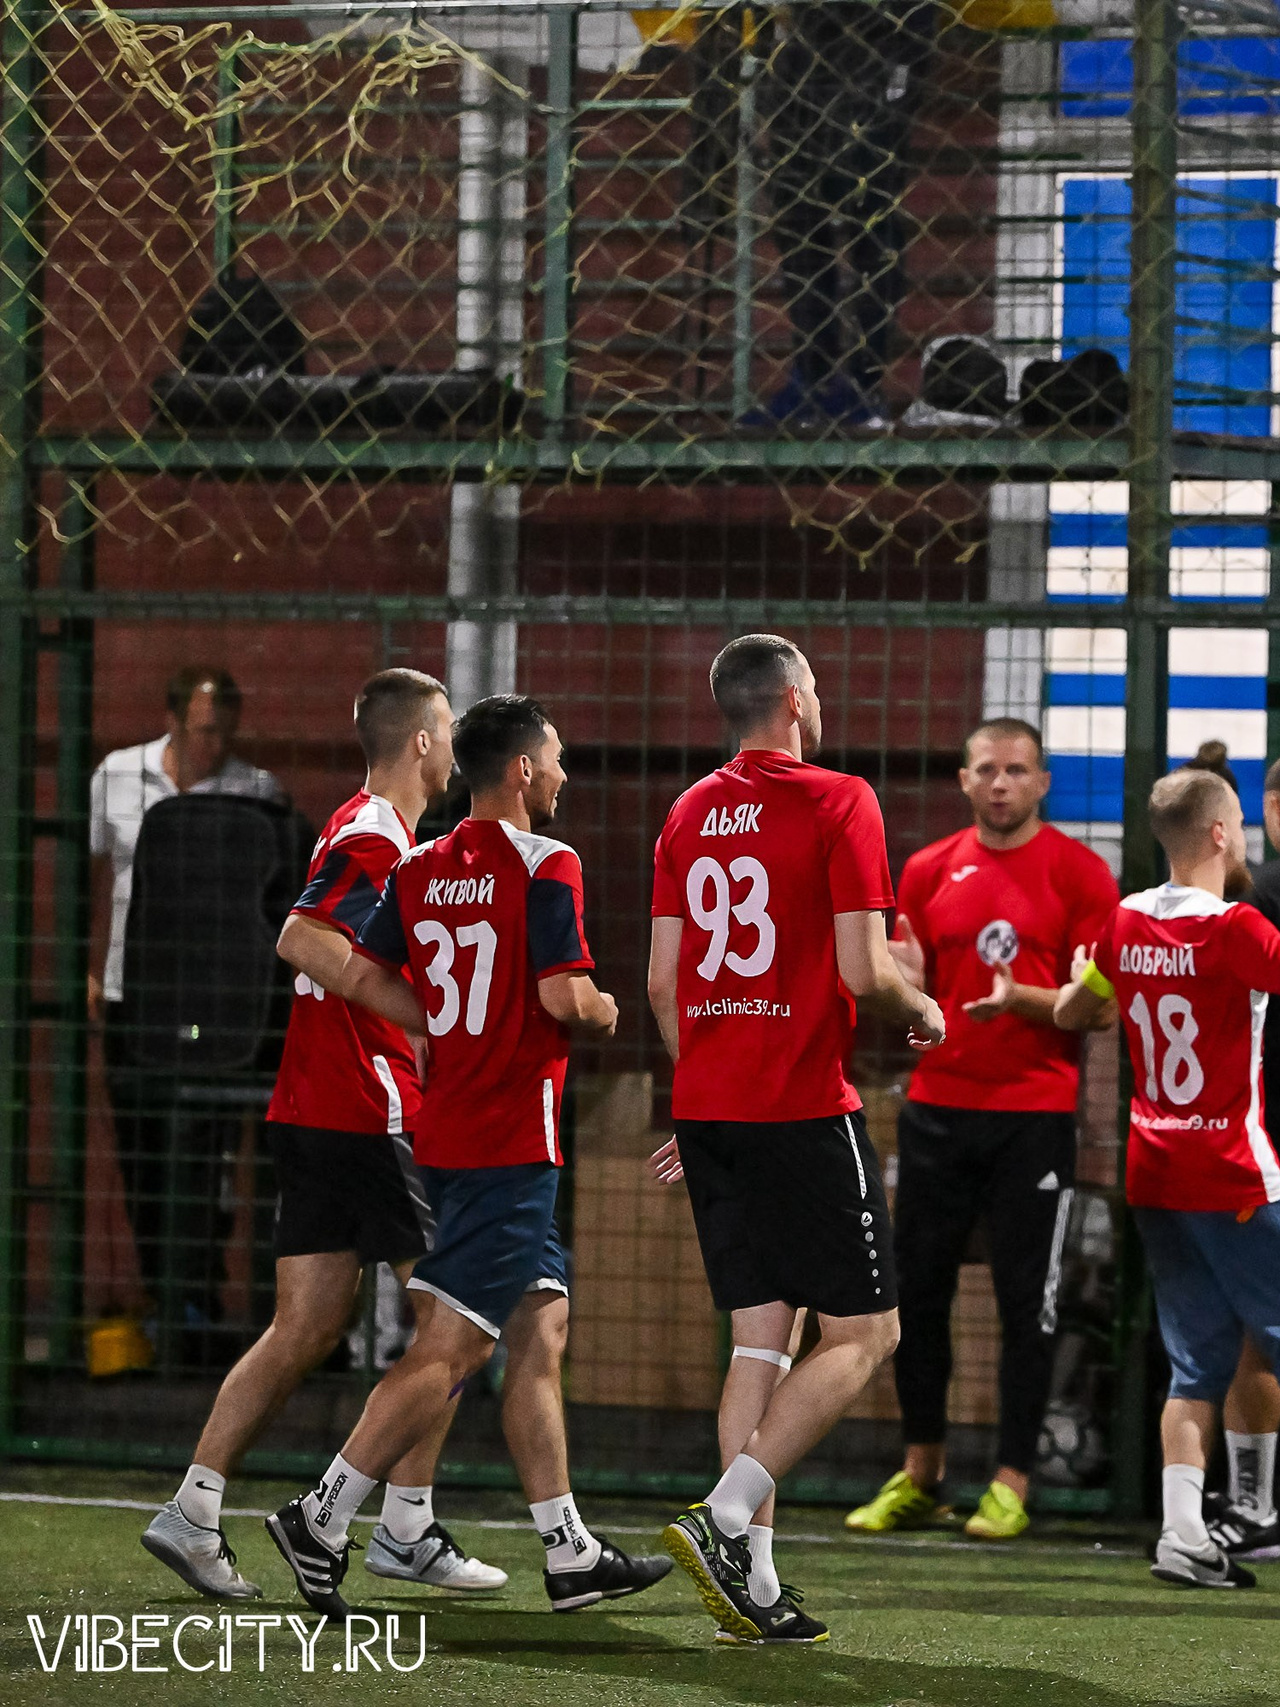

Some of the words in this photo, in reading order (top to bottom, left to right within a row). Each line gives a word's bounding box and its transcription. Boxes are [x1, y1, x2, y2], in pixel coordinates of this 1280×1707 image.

[699, 803, 763, 836] ДЬЯК
[424, 873, 495, 906] ЖИВОЙ
[686, 856, 776, 982] 93
[1119, 942, 1196, 977] ДОБРЫЙ
[413, 920, 498, 1037] 37
[686, 997, 791, 1019] w.lclinic39.ru
[1128, 991, 1205, 1105] 18
